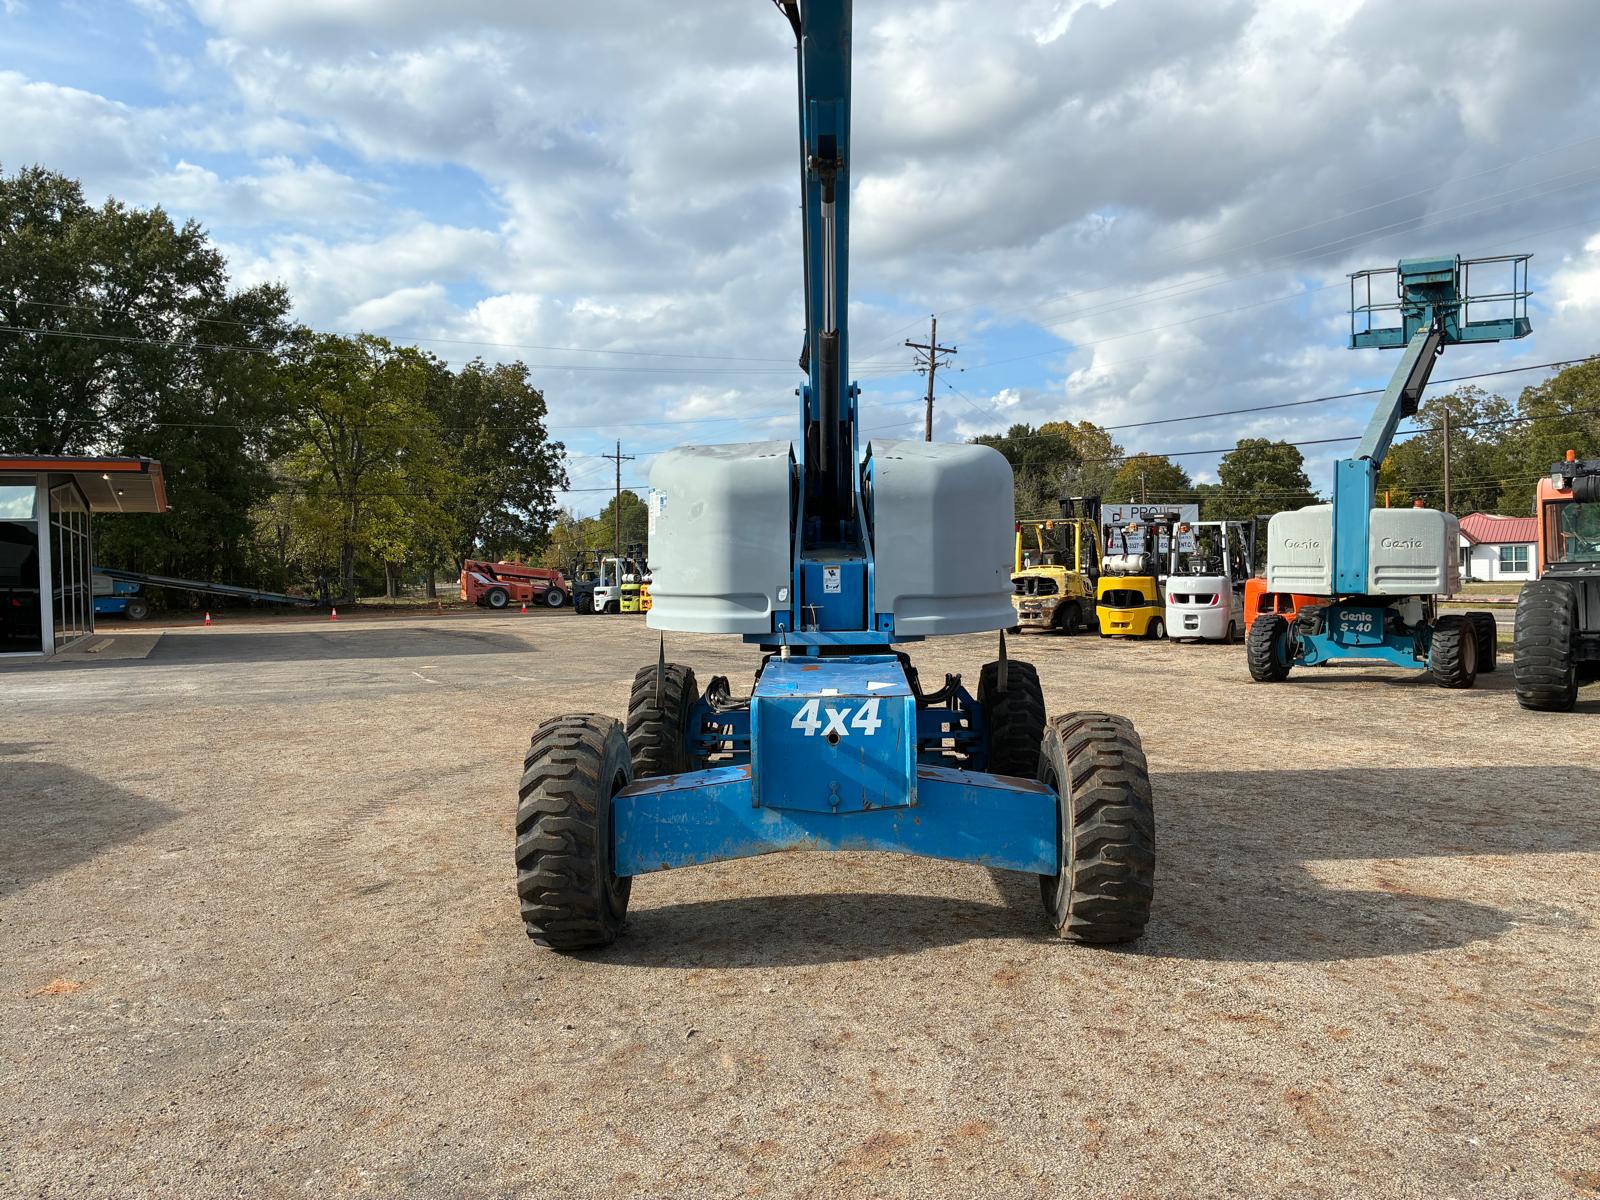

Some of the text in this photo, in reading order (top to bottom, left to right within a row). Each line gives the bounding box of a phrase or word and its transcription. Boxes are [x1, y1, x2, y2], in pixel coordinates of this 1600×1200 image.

[1284, 538, 1320, 549] Genie
[1381, 537, 1423, 549] Genie
[1339, 611, 1373, 622] Genie
[791, 698, 882, 736] 4x4
